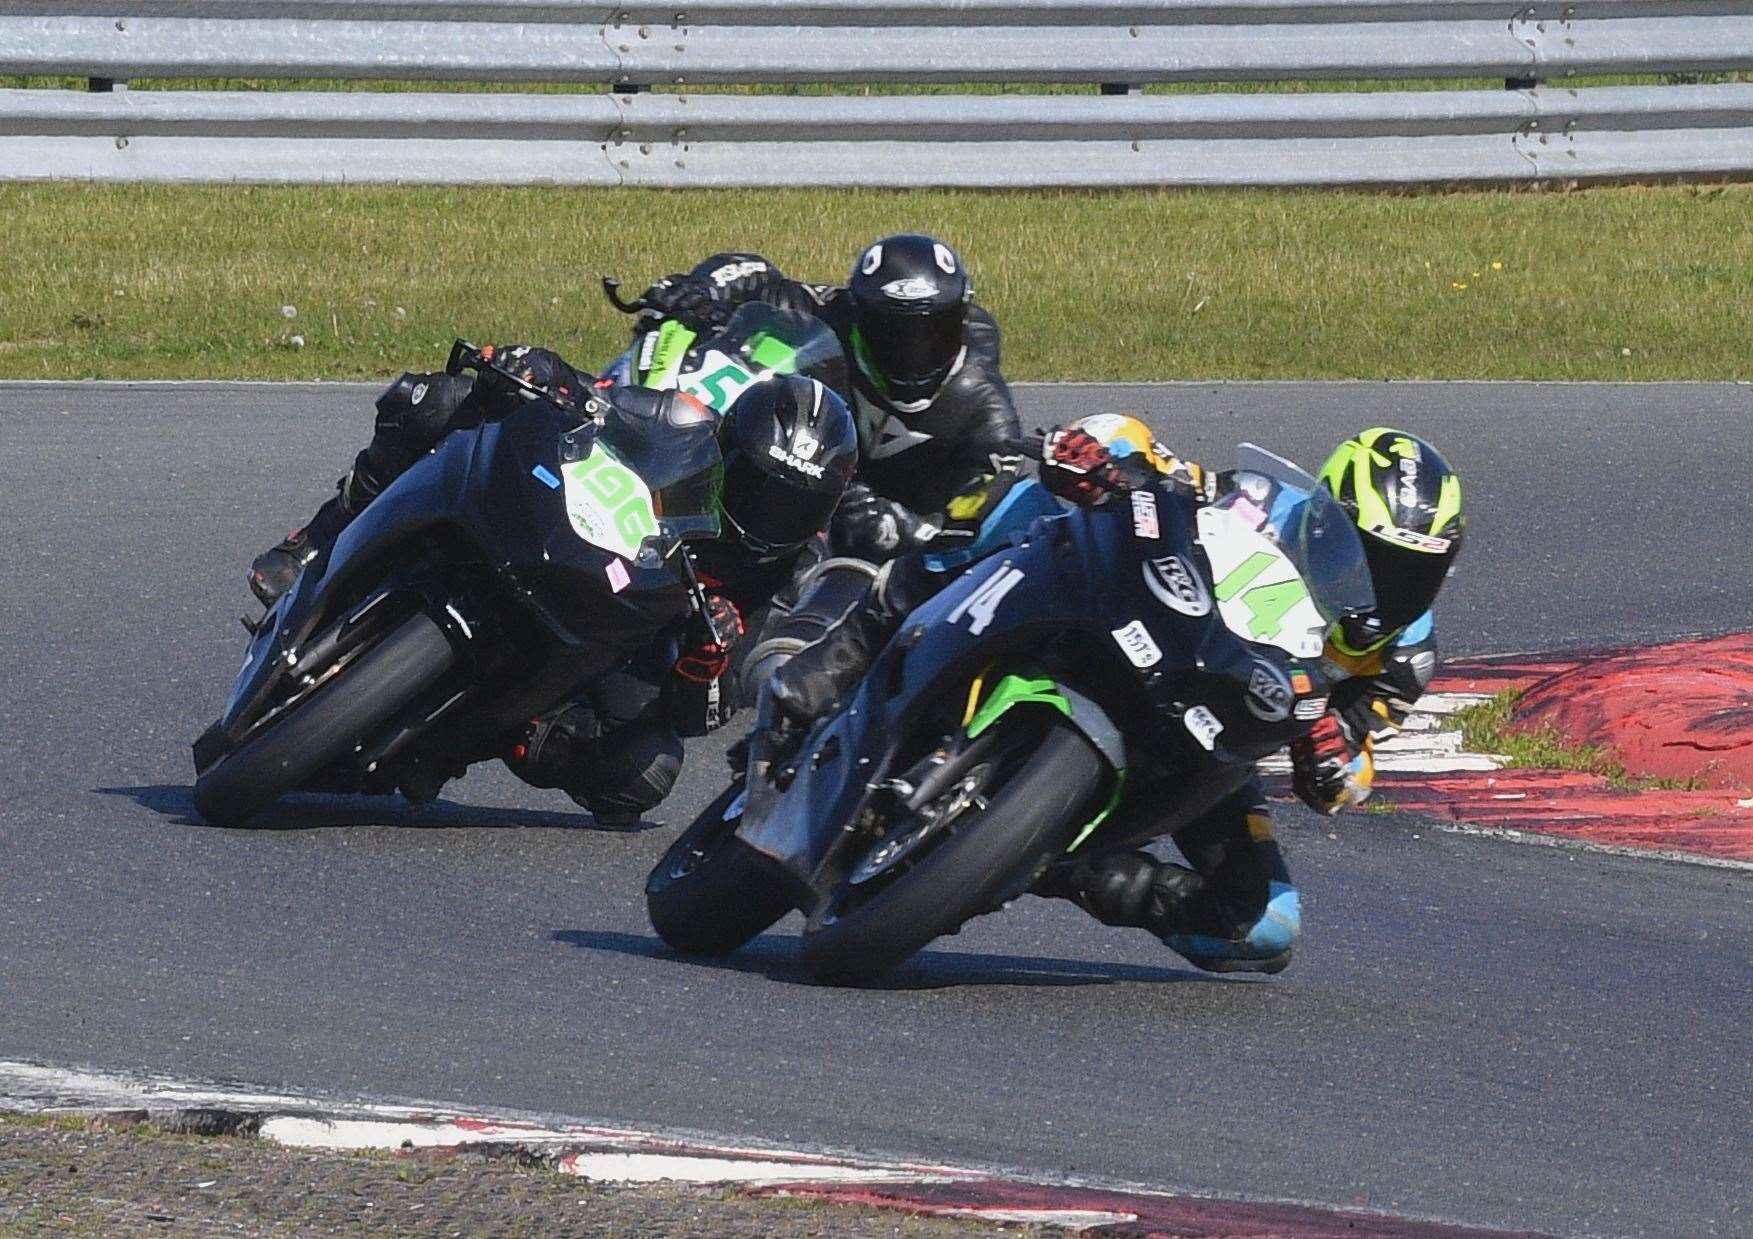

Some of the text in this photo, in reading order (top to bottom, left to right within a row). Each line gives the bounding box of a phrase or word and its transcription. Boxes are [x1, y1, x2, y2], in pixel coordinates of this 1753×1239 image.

[687, 365, 751, 412] 5
[769, 445, 825, 479] SHARK
[572, 454, 655, 548] 196
[946, 566, 1026, 636] 14
[1214, 551, 1308, 640] 14
